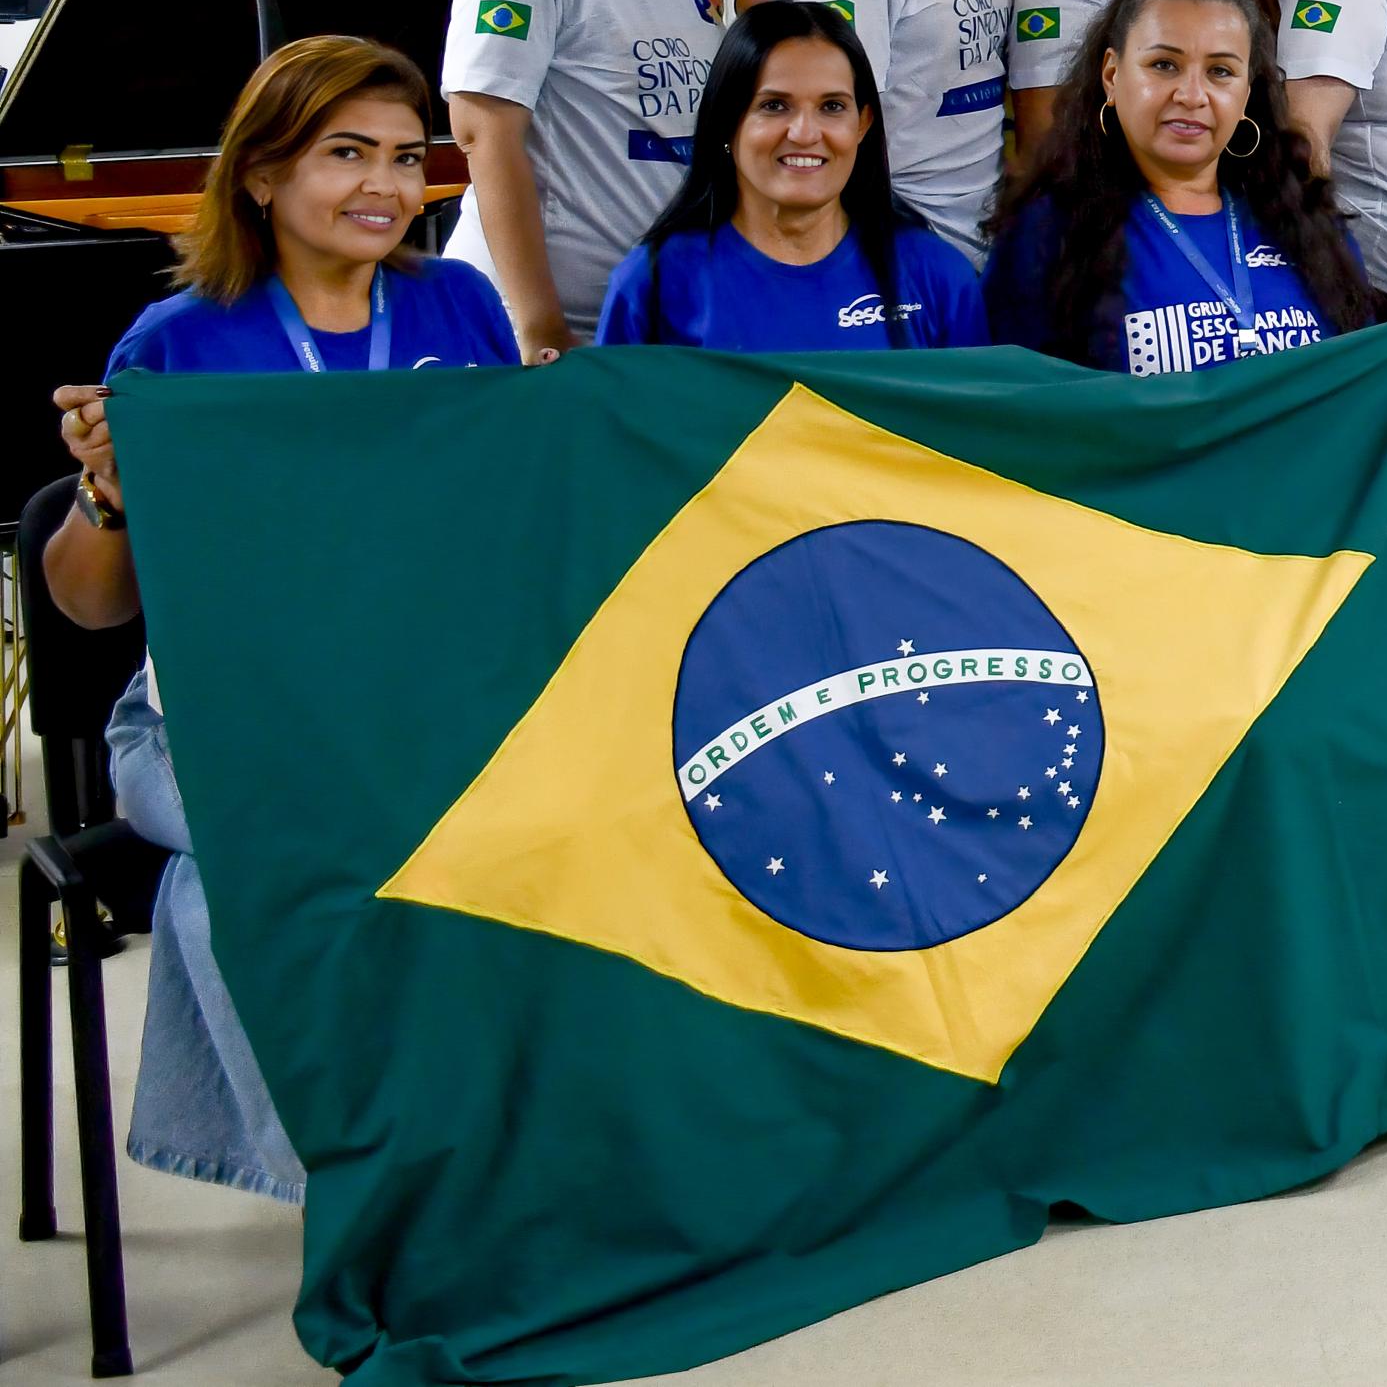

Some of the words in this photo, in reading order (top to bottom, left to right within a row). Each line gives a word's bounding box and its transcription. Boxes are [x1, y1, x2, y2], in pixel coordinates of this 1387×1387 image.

[633, 37, 690, 62] CORO
[638, 90, 682, 117] DA
[1188, 301, 1228, 318] GRU
[1191, 317, 1239, 340] SESC
[1253, 306, 1320, 332] ARAÍBA
[1193, 338, 1227, 366] DE
[687, 700, 798, 786] ORDEM
[815, 688, 833, 705] E
[857, 655, 1083, 695] PROGRESSO
